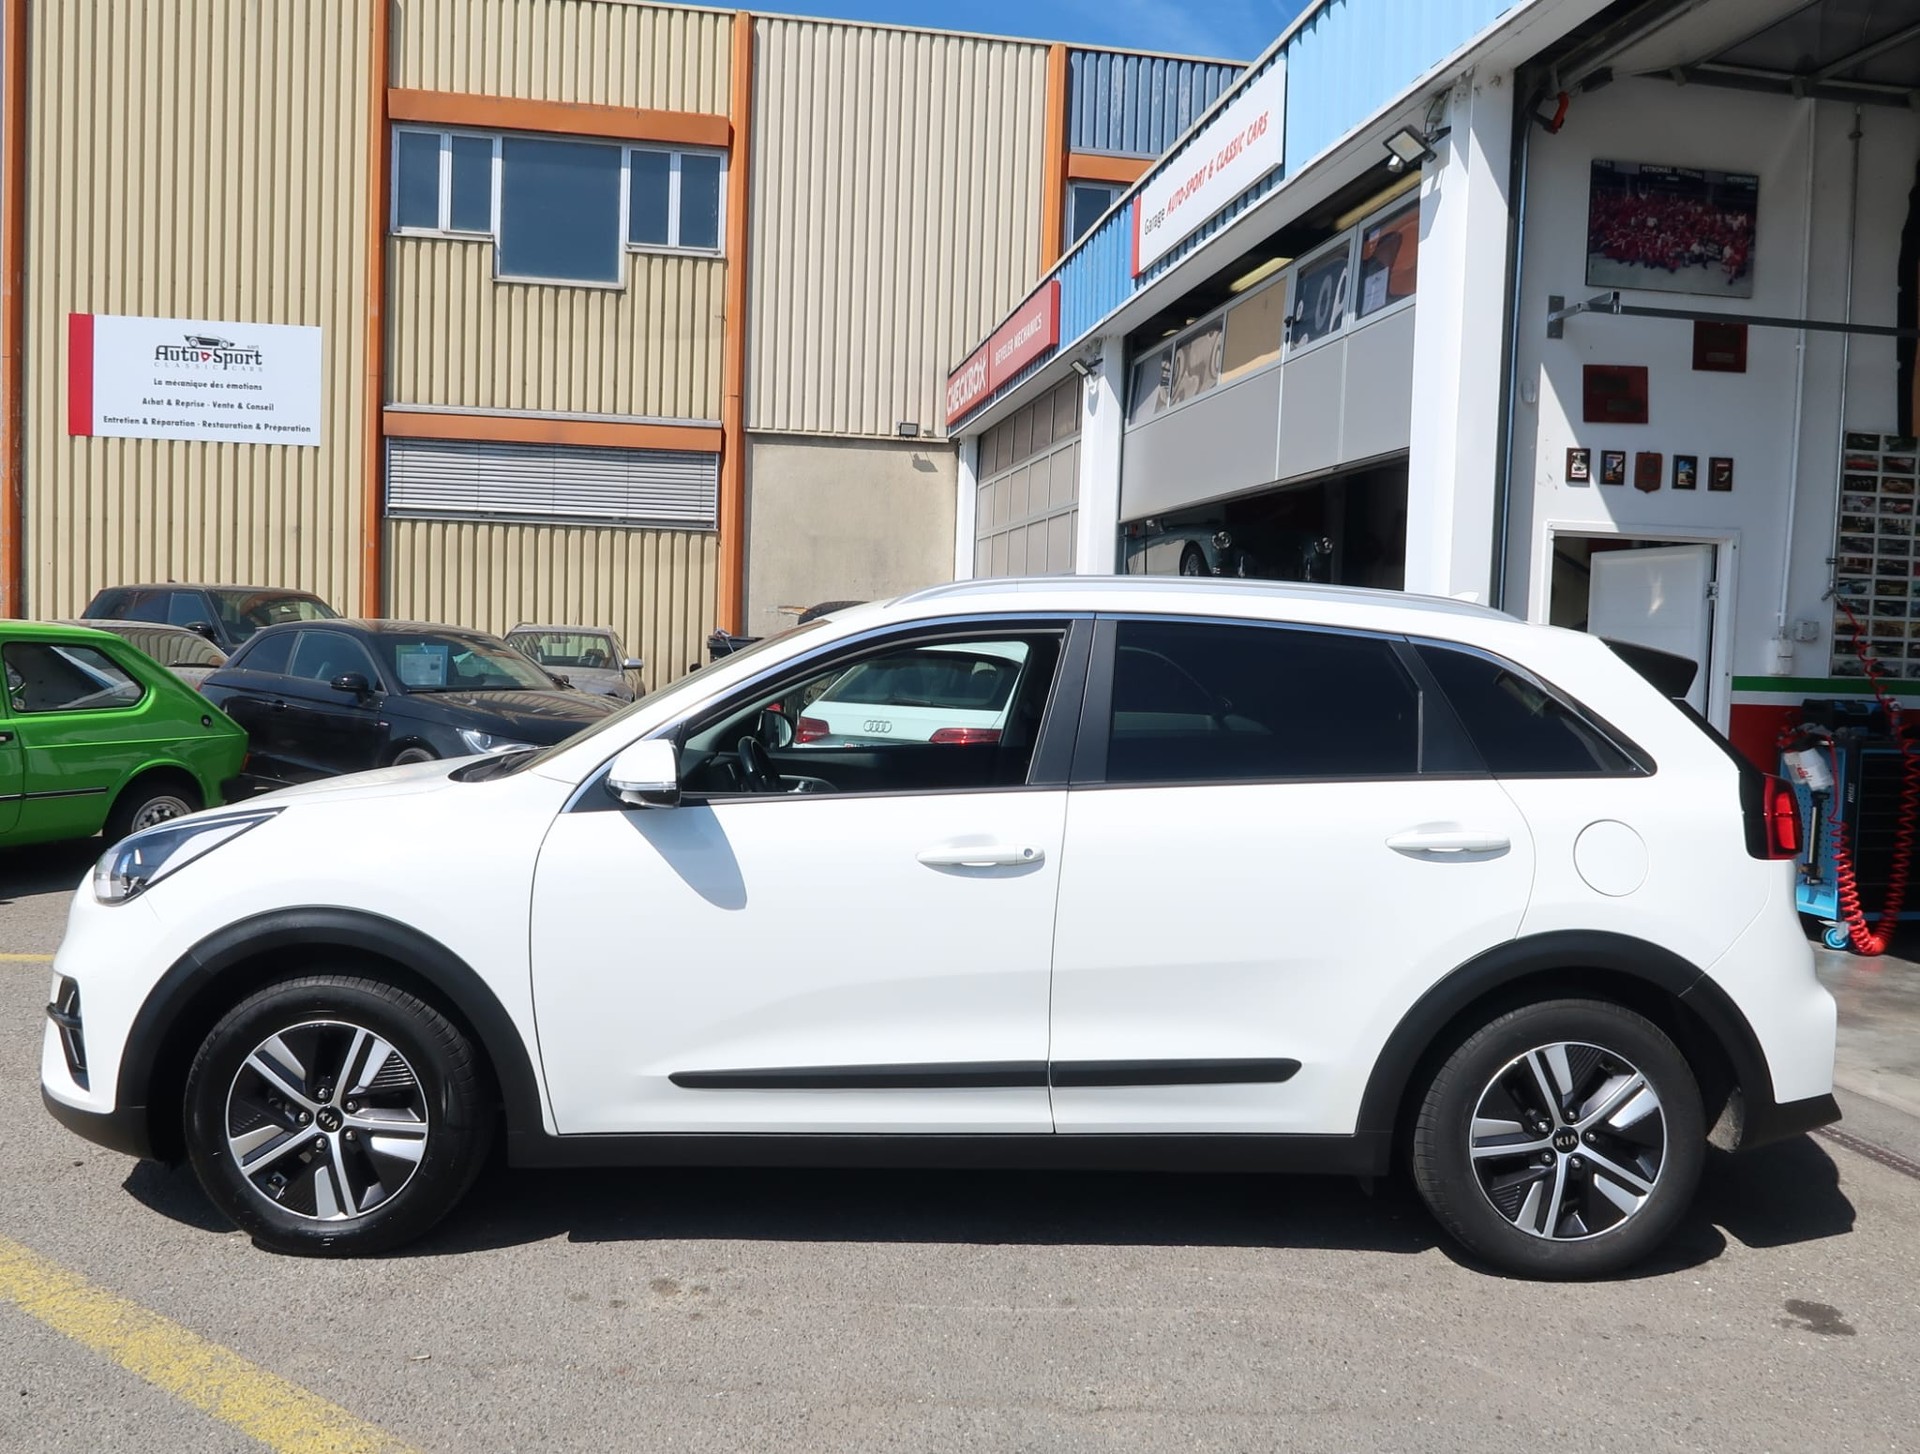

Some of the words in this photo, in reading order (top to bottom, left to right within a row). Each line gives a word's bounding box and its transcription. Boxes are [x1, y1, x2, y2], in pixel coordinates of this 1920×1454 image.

[1144, 208, 1165, 235] Garage
[1165, 166, 1206, 216] AUTO-SPORT
[1207, 158, 1214, 180] &
[1216, 129, 1245, 172] CLASSIC
[1246, 110, 1269, 147] CARS
[154, 345, 200, 362] Auto
[213, 347, 263, 370] Sport
[154, 361, 218, 371] CLASSIC
[232, 364, 263, 373] CARS
[153, 378, 163, 386] La
[210, 380, 224, 389] des
[946, 353, 987, 417] CHECKBOX
[142, 397, 164, 405] Achat
[166, 398, 173, 406] &
[175, 399, 205, 409] Reprise
[212, 401, 235, 409] Vente
[237, 402, 243, 410] &
[246, 402, 274, 411] Conseil
[103, 415, 140, 425] Entretien
[142, 417, 148, 425] &
[202, 420, 253, 430] Restauration
[255, 422, 262, 430] &
[319, 1110, 339, 1131] KIA
[1555, 1134, 1578, 1147] KIA
